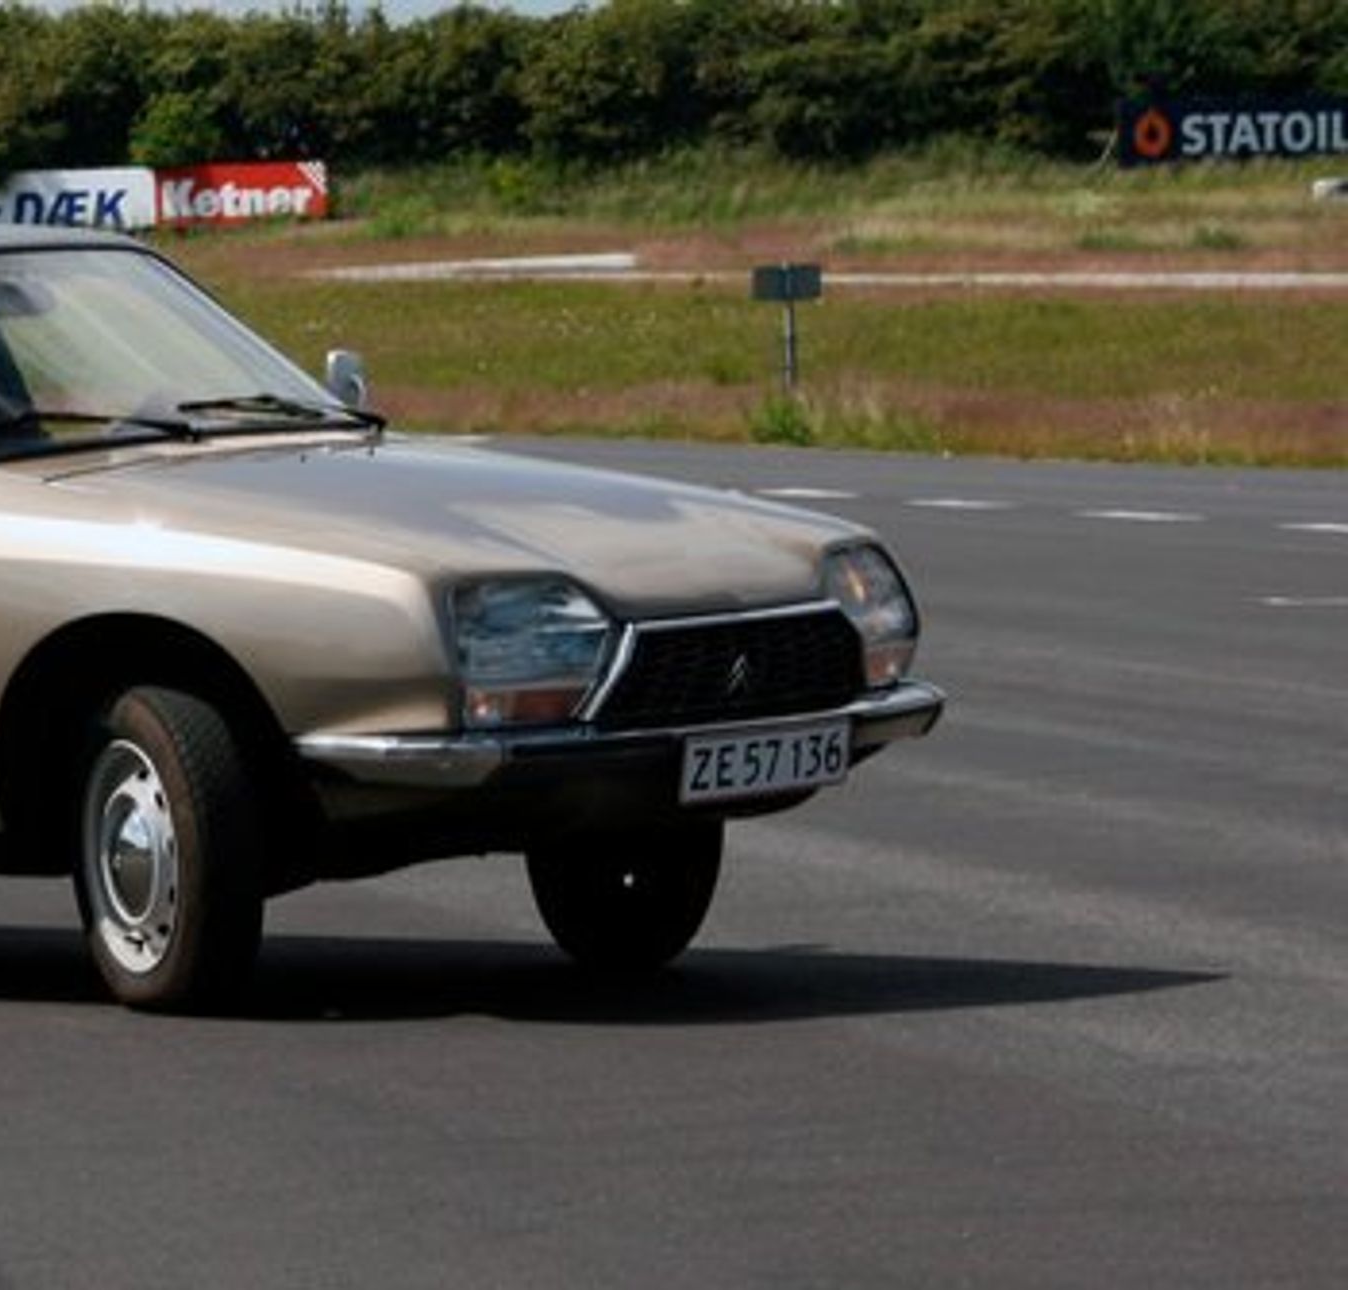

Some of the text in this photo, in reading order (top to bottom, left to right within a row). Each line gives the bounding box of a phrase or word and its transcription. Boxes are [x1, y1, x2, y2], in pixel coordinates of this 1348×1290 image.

[1181, 112, 1348, 154] STATOIL
[162, 179, 312, 217] Ketner
[690, 732, 841, 790] ZE 57 136
